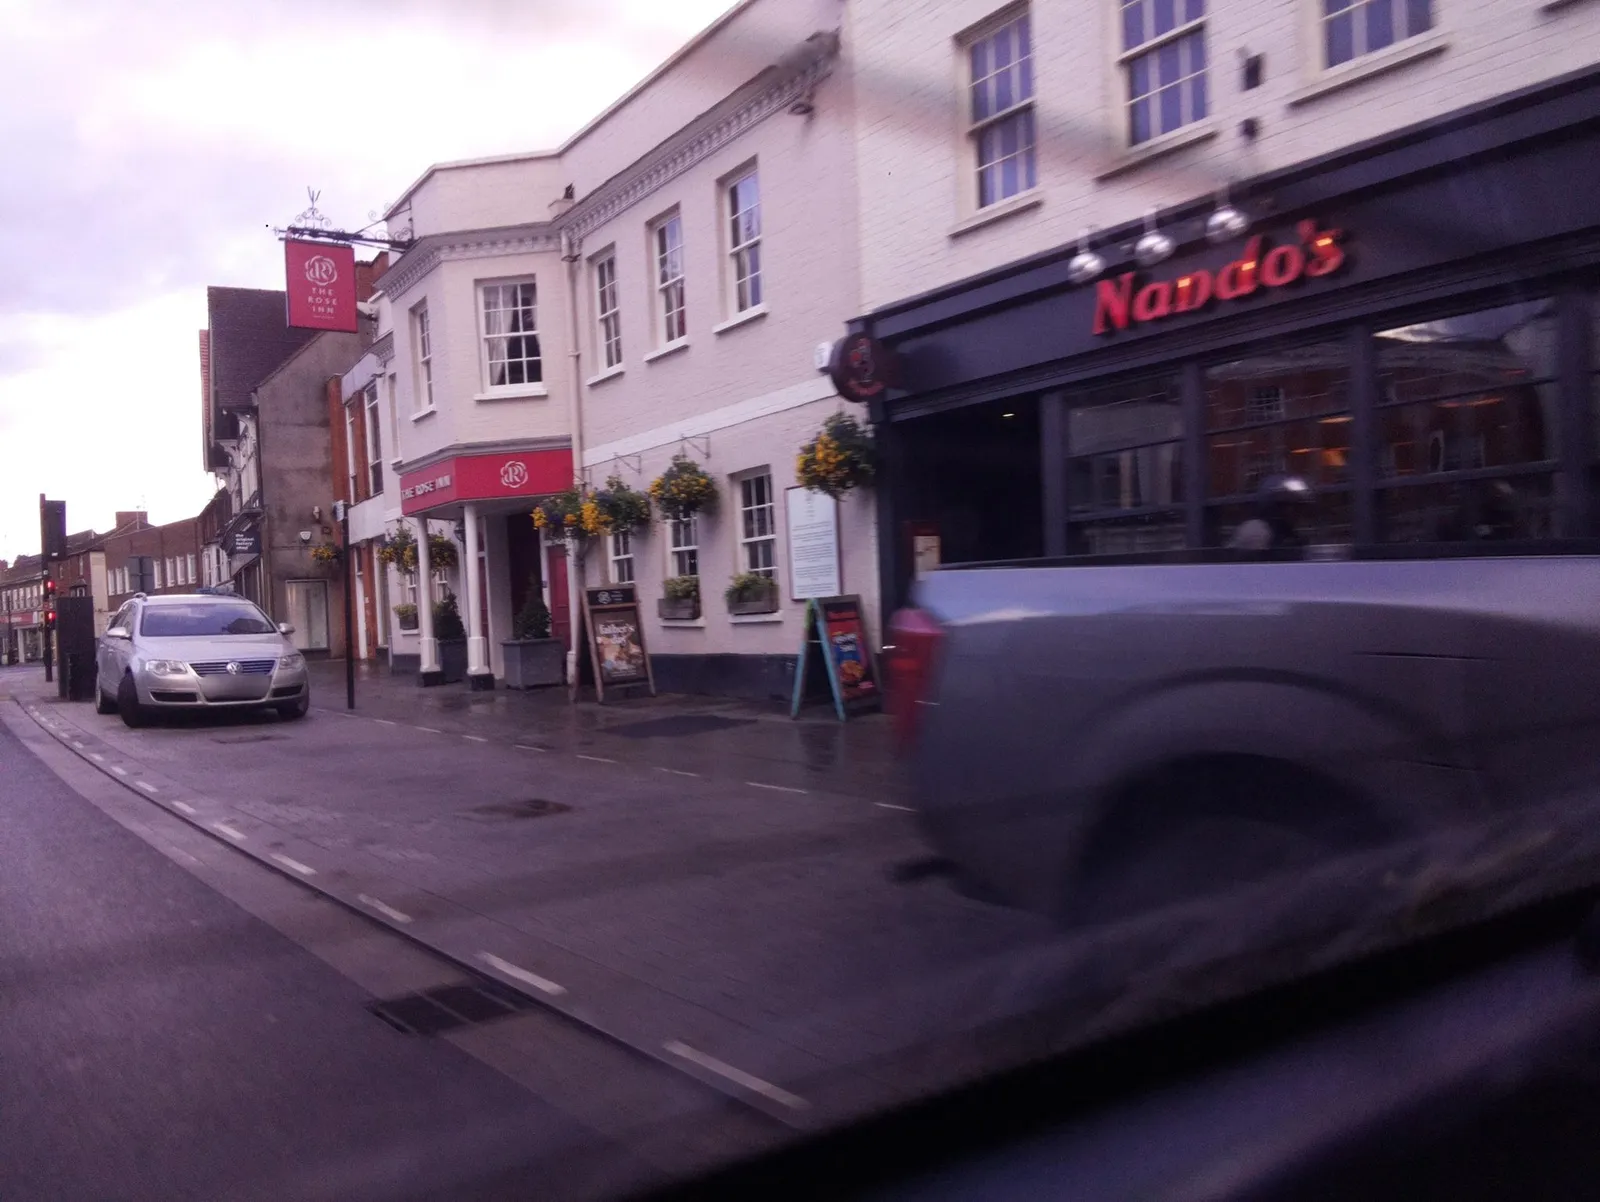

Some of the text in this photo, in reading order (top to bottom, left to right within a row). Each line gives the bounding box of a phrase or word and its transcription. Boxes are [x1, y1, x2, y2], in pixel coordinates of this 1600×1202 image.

[1092, 218, 1345, 335] Nando's
[312, 287, 333, 296] THE
[307, 295, 337, 306] ROSE
[312, 306, 334, 314] INN
[400, 486, 415, 500] THE
